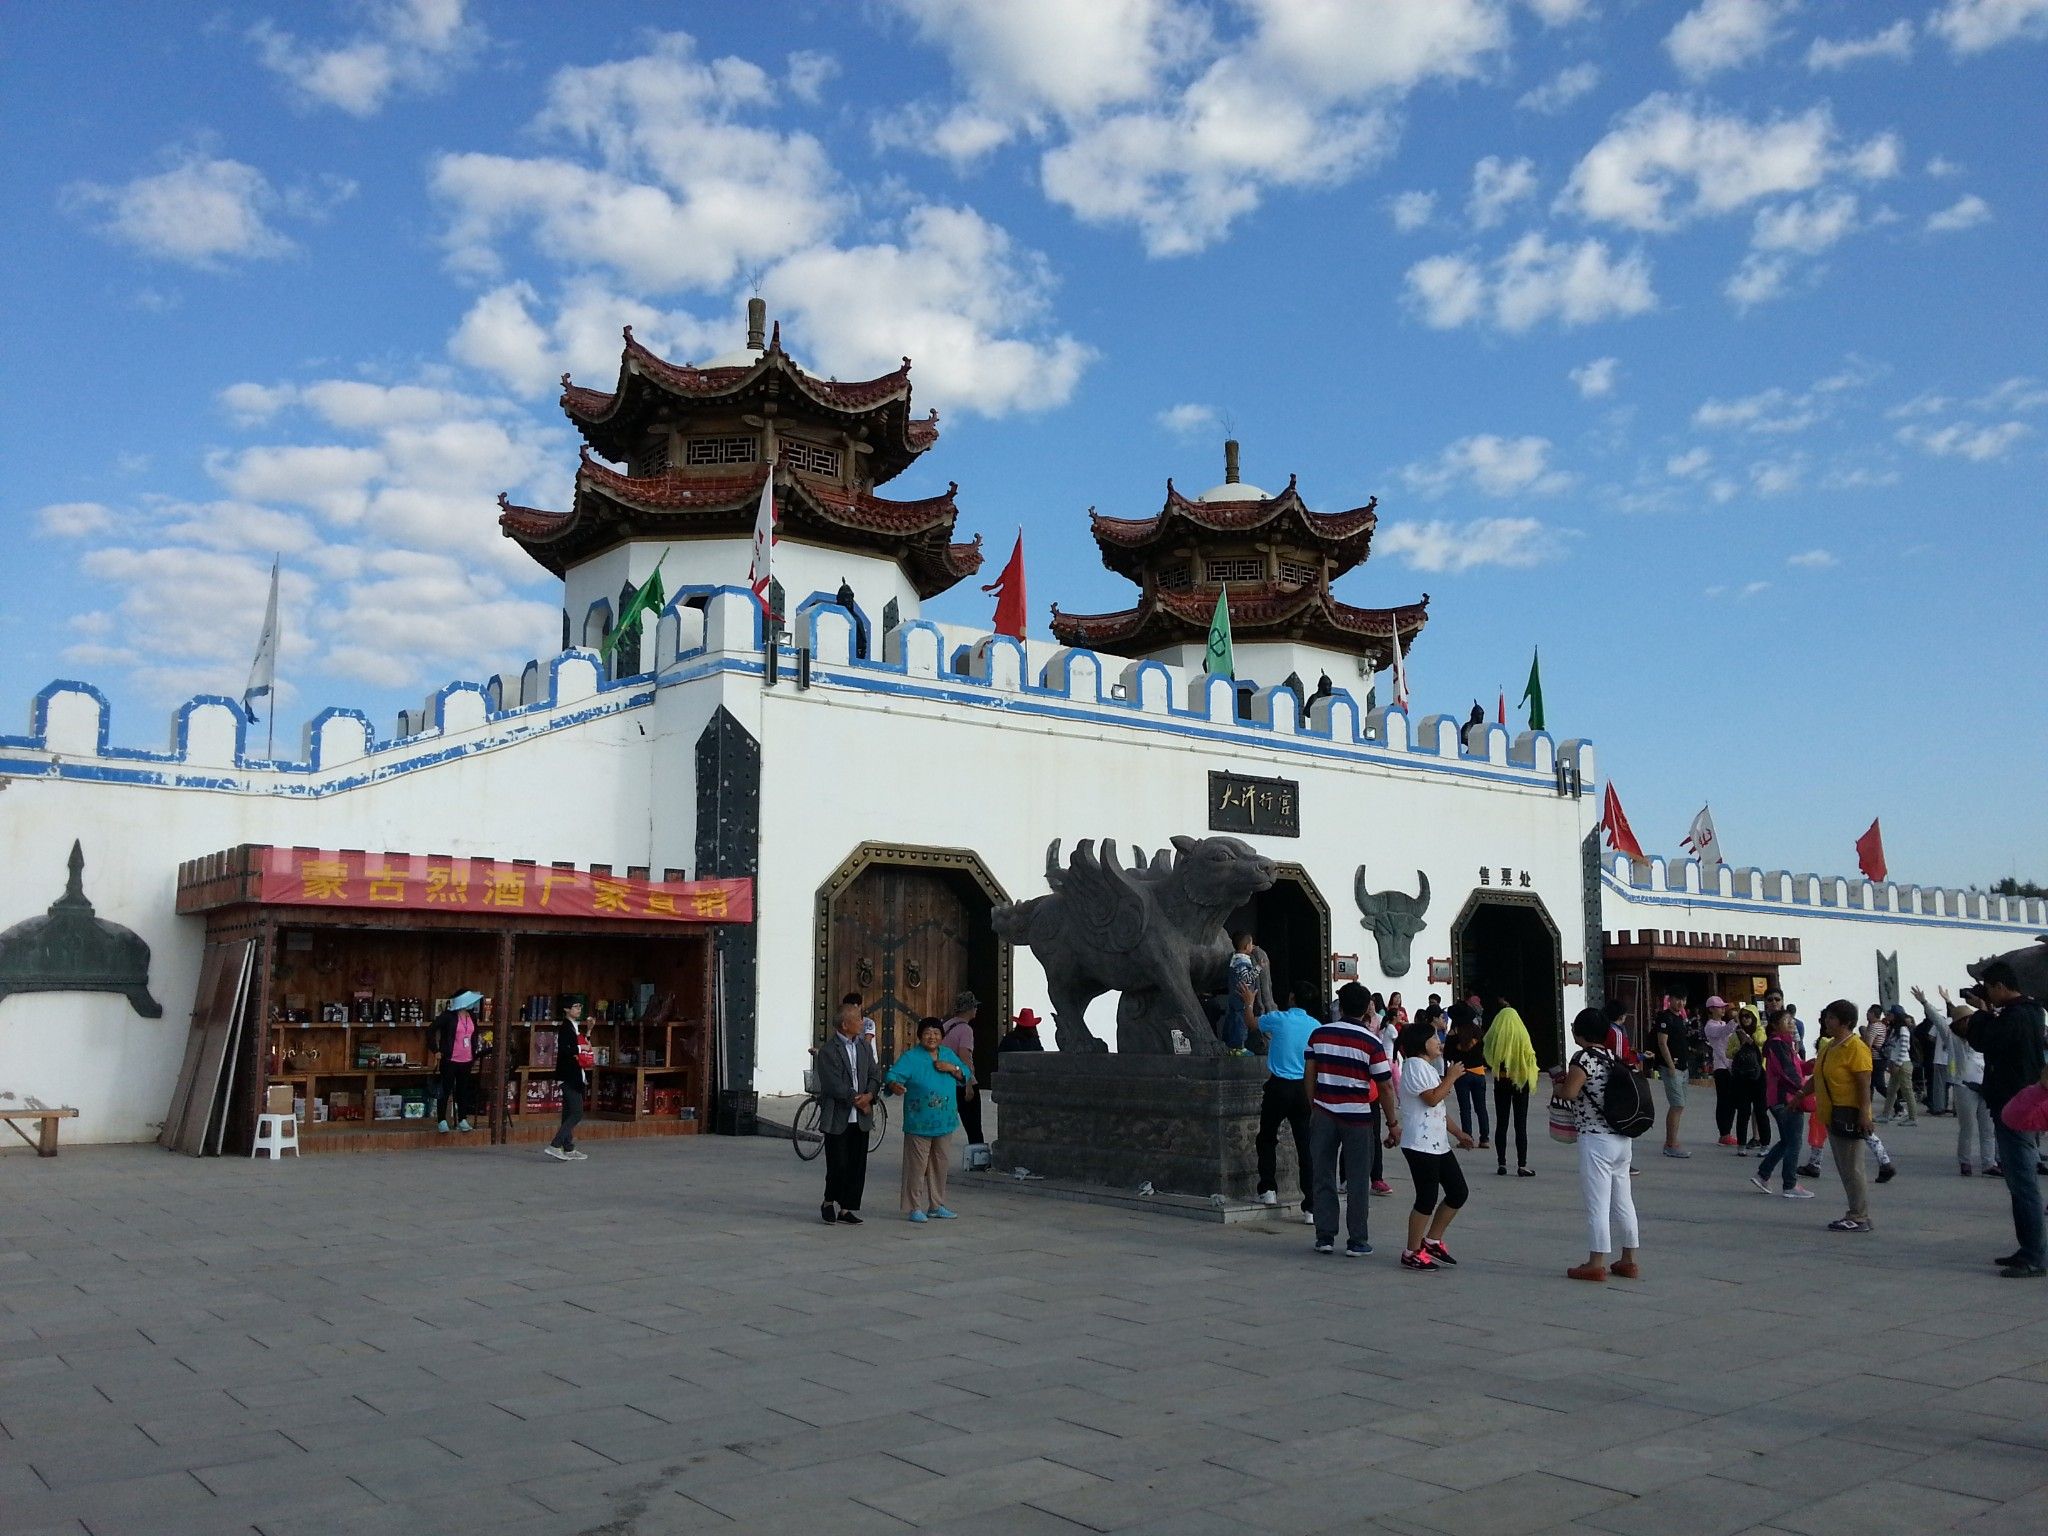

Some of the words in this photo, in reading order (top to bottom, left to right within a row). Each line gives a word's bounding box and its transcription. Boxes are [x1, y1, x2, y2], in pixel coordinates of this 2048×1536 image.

[300, 859, 729, 918] 蒙古烈酒厂家直销
[1478, 866, 1531, 887] 售票处
